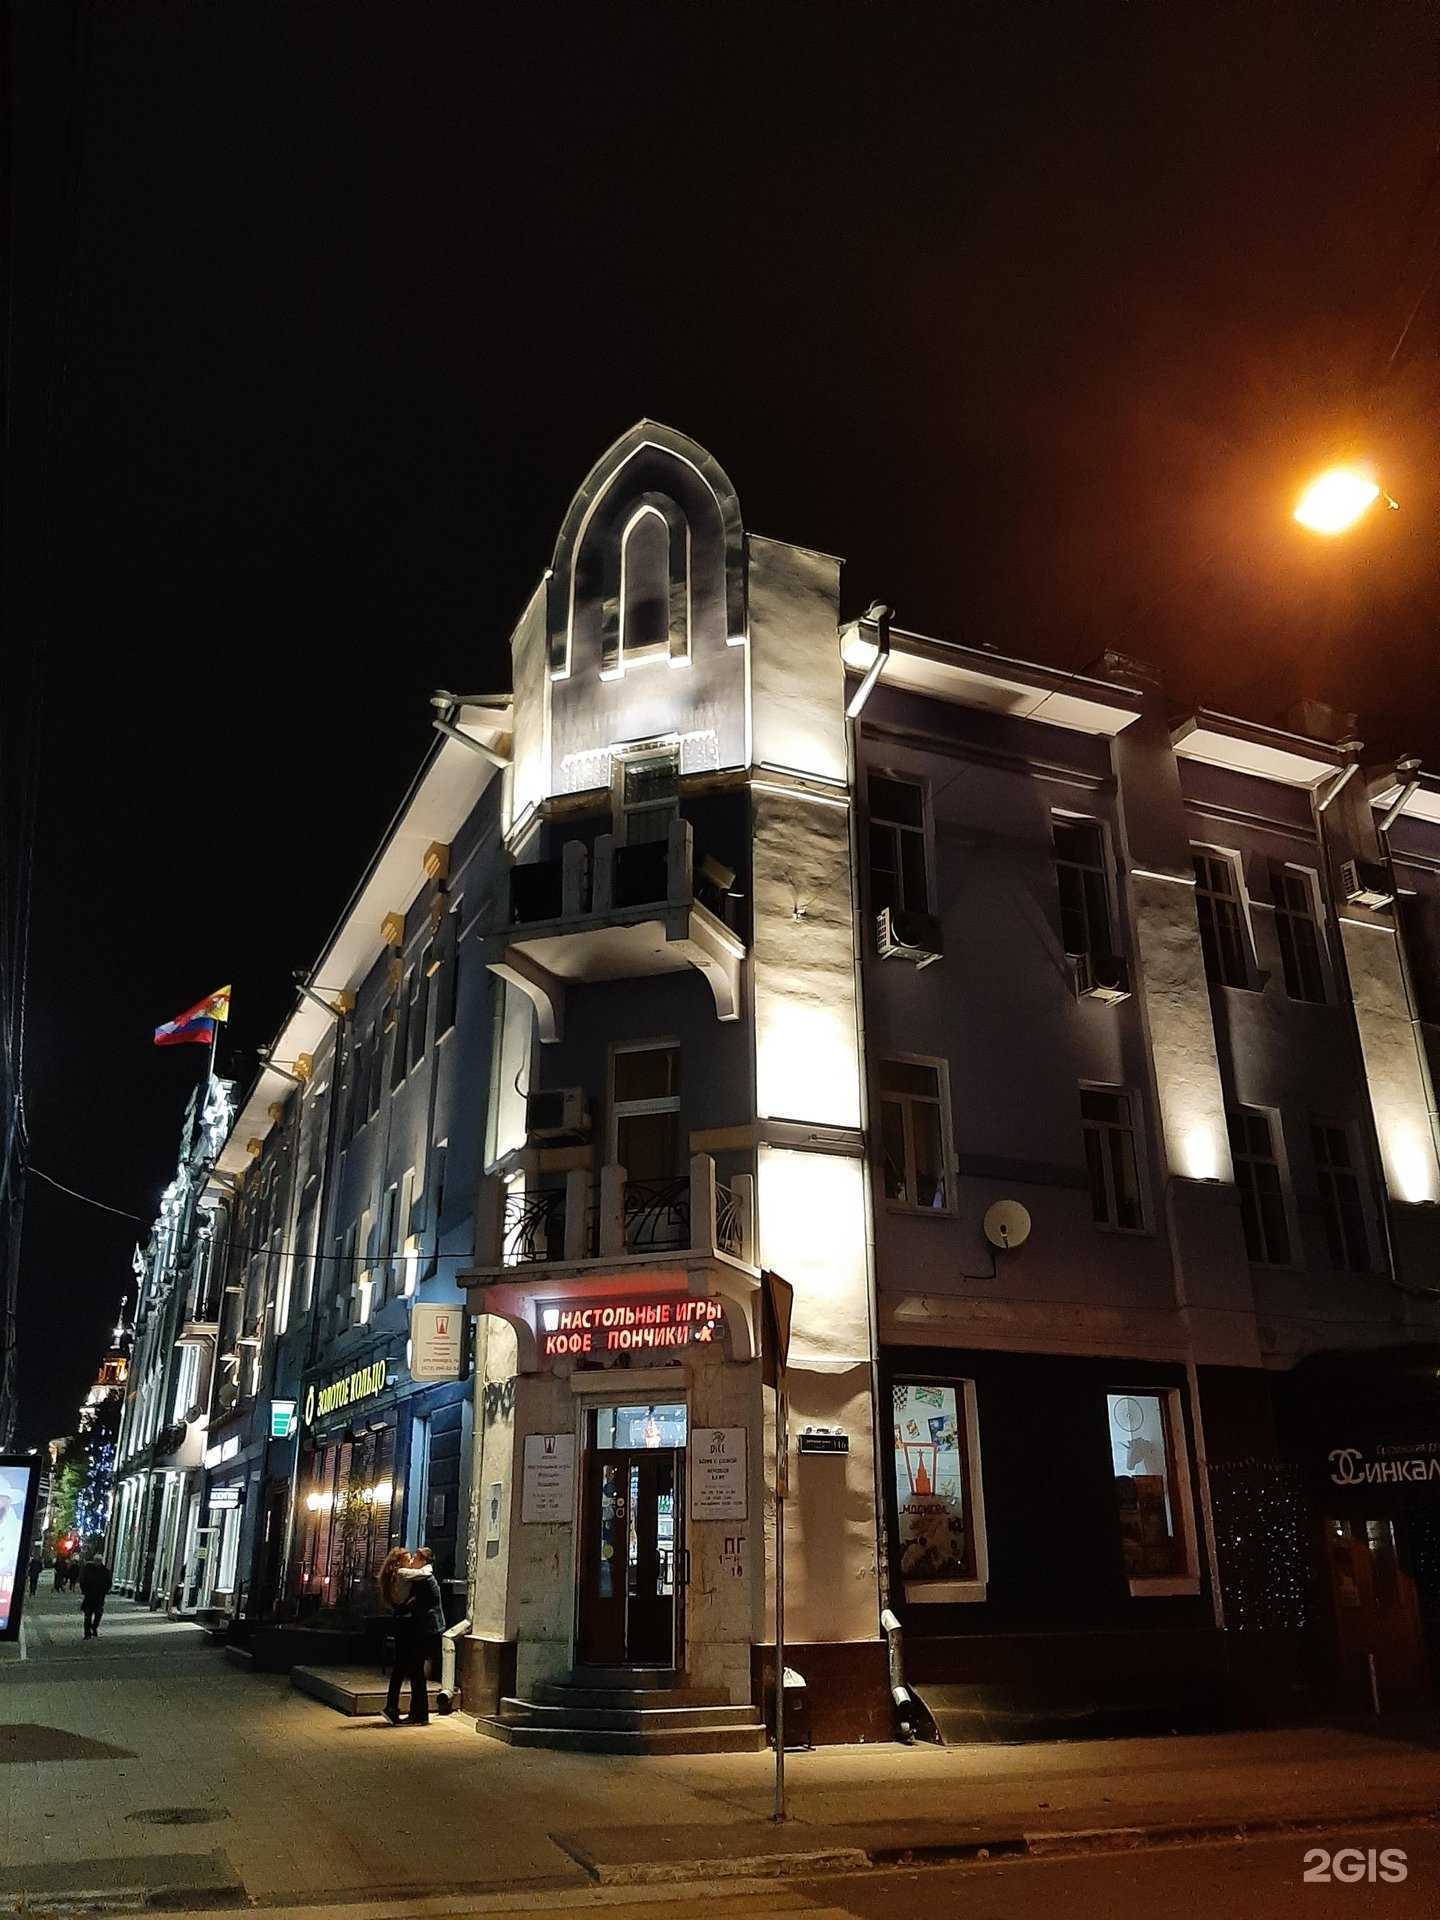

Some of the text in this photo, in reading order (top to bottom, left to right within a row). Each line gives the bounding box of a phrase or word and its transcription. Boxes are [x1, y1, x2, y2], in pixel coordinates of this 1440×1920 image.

[560, 1301, 722, 1331] НАСТОЛЬНЫЕ ИГРЫ
[546, 1326, 689, 1355] КОФЕ ПОНЧИКИ
[316, 1359, 386, 1417] ЗОЛОТОЕ КОЛЬЦО
